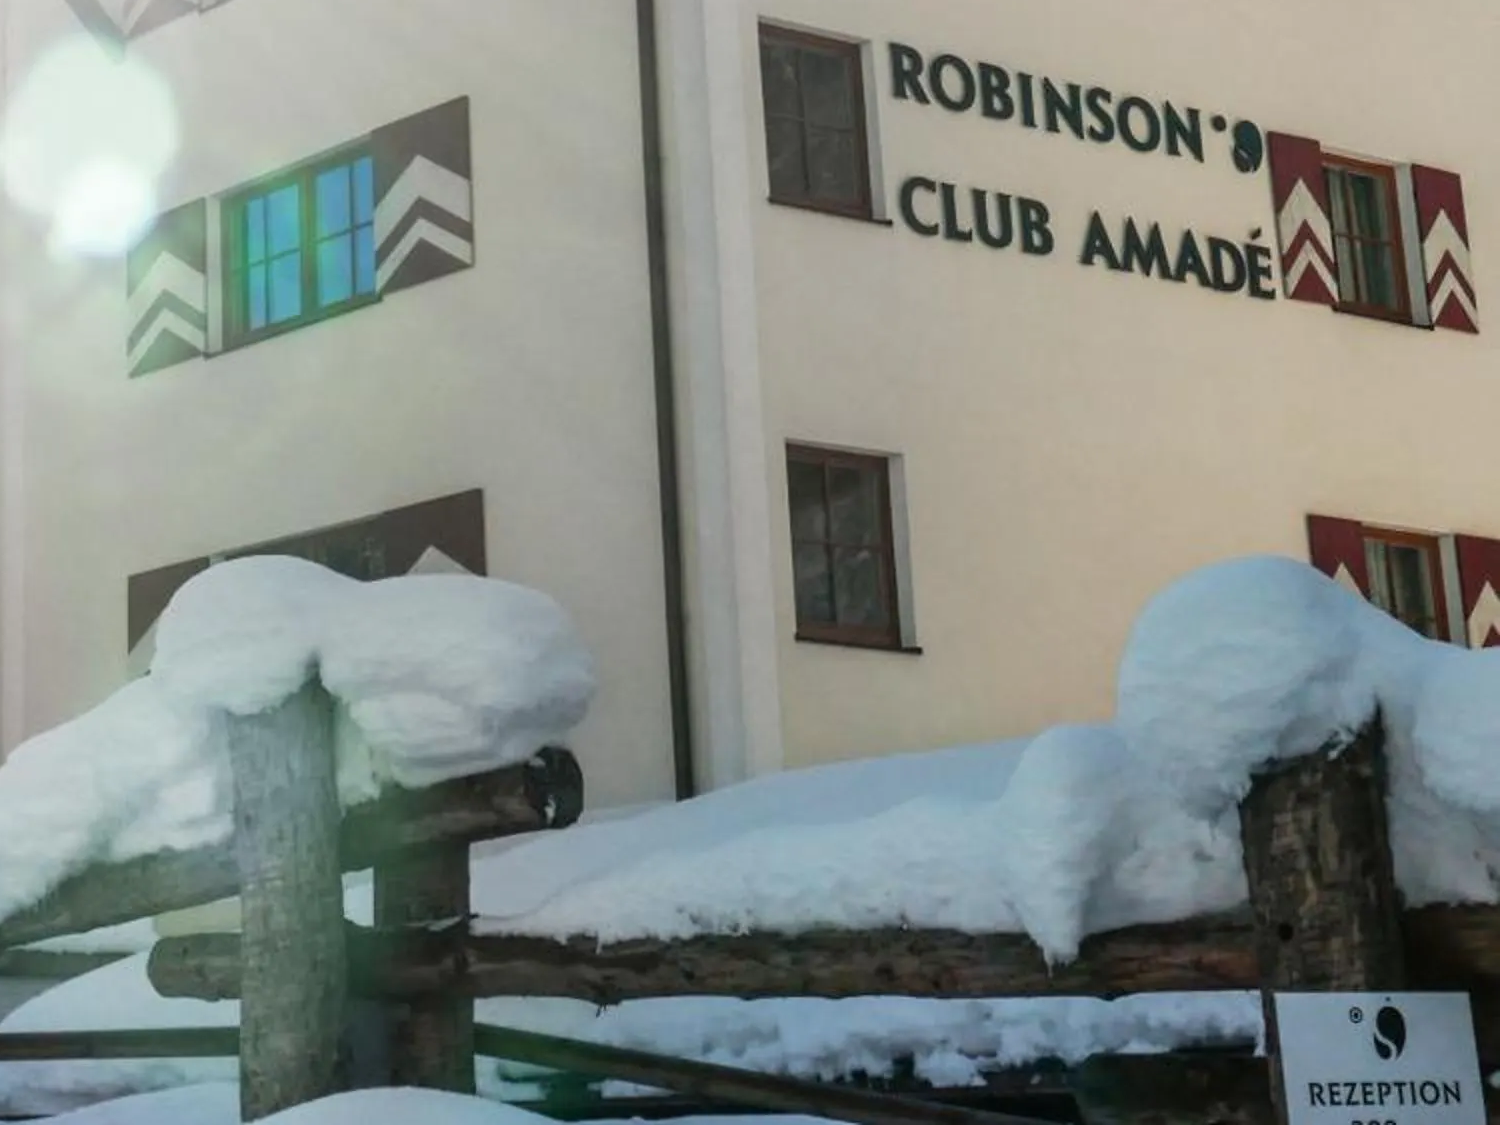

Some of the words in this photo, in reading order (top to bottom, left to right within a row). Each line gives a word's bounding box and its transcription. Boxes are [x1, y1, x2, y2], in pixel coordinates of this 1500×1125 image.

[888, 41, 1204, 163] ROBINSON
[900, 175, 1055, 255] CLUB
[1079, 210, 1277, 300] AMADÉ
[1308, 1080, 1462, 1106] REZEPTION
